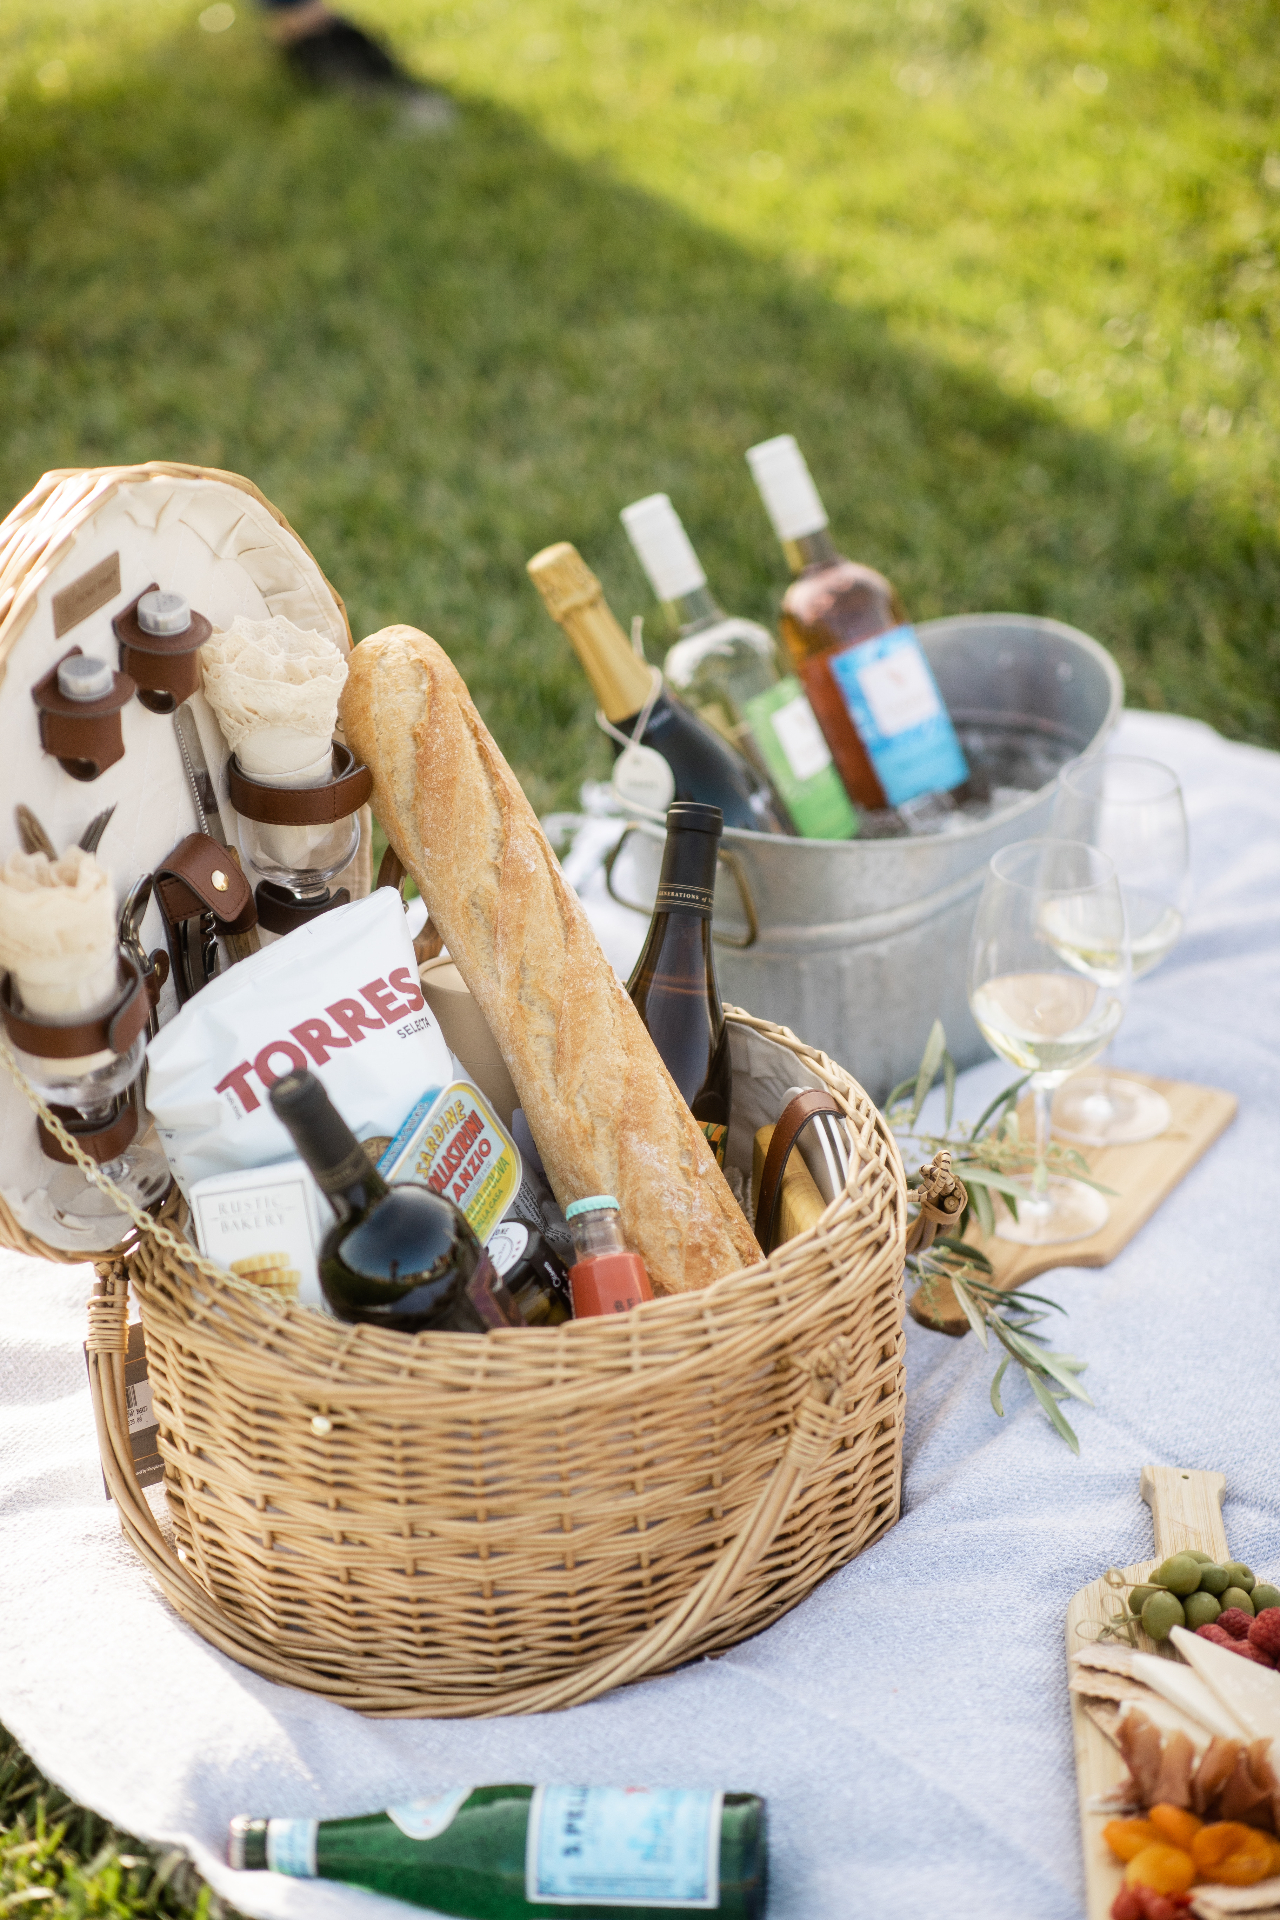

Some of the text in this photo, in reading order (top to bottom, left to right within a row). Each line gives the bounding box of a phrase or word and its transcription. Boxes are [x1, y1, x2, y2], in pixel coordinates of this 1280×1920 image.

[214, 967, 425, 1113] TORRES
[396, 1016, 431, 1039] SELECTA
[415, 1099, 467, 1180] SARDINE
[428, 1109, 485, 1194] OLLASTRINI
[452, 1138, 492, 1203] ANZIO
[217, 1193, 285, 1215] RUSTIC
[488, 1188, 504, 1209] CASA
[220, 1212, 285, 1235] BAKERY
